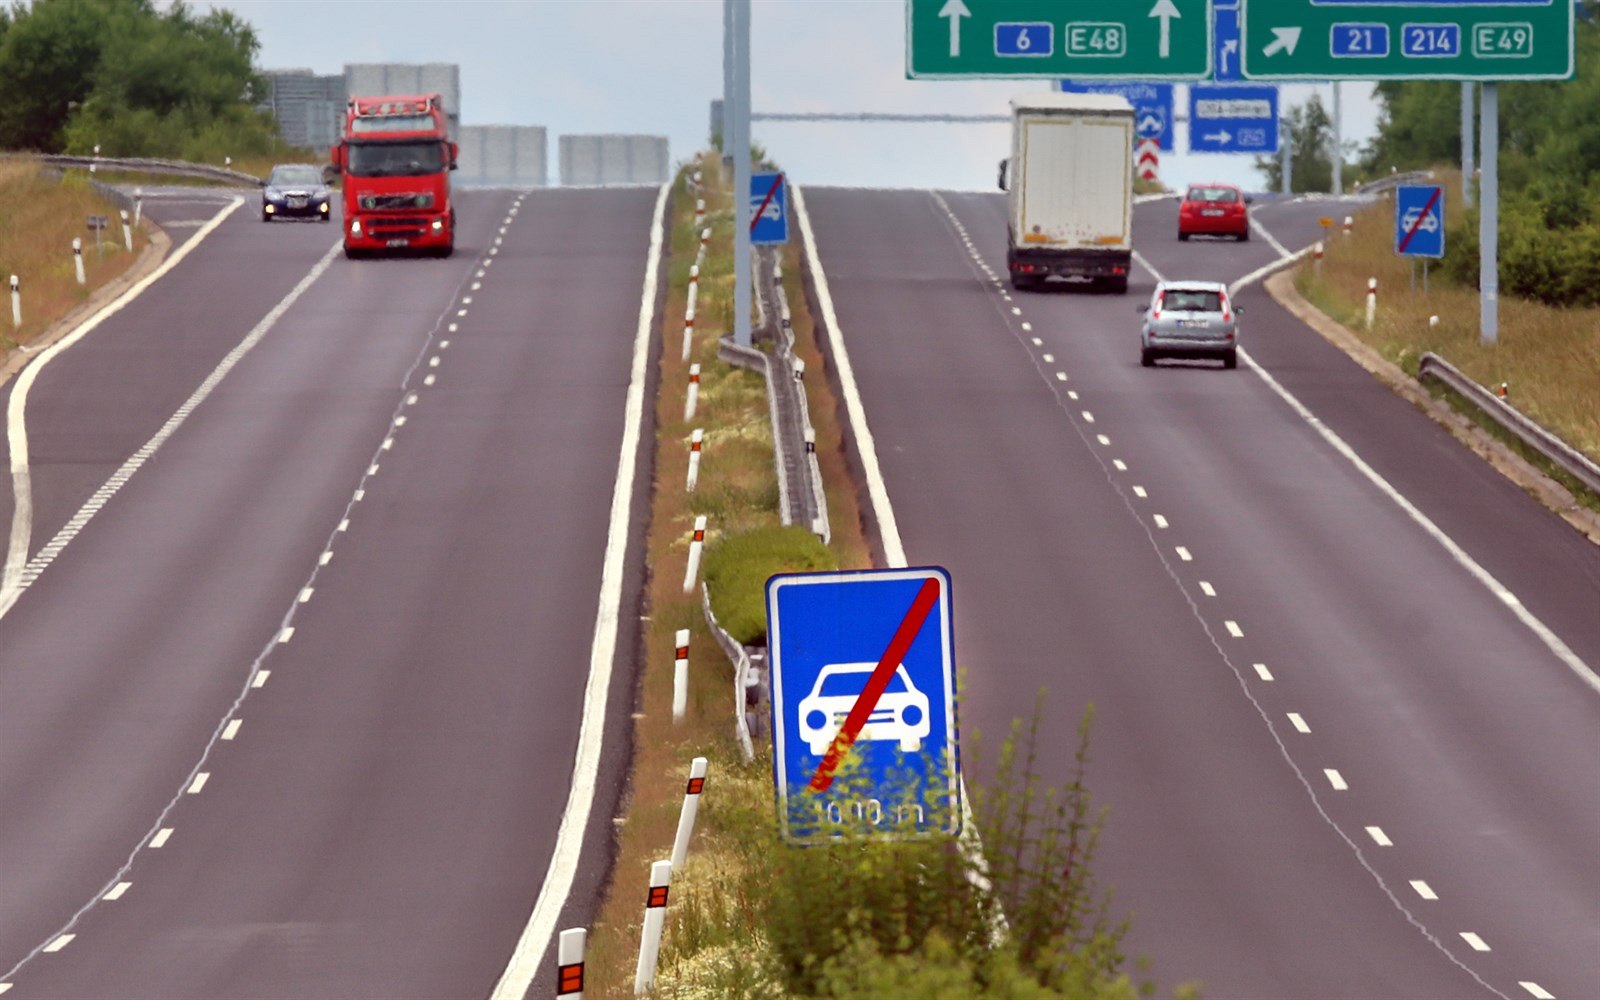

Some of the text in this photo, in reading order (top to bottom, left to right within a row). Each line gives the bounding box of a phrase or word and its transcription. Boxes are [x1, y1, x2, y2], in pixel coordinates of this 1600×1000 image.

[1016, 28, 1119, 50] 6 E48
[1348, 29, 1527, 51] 21 214 E49
